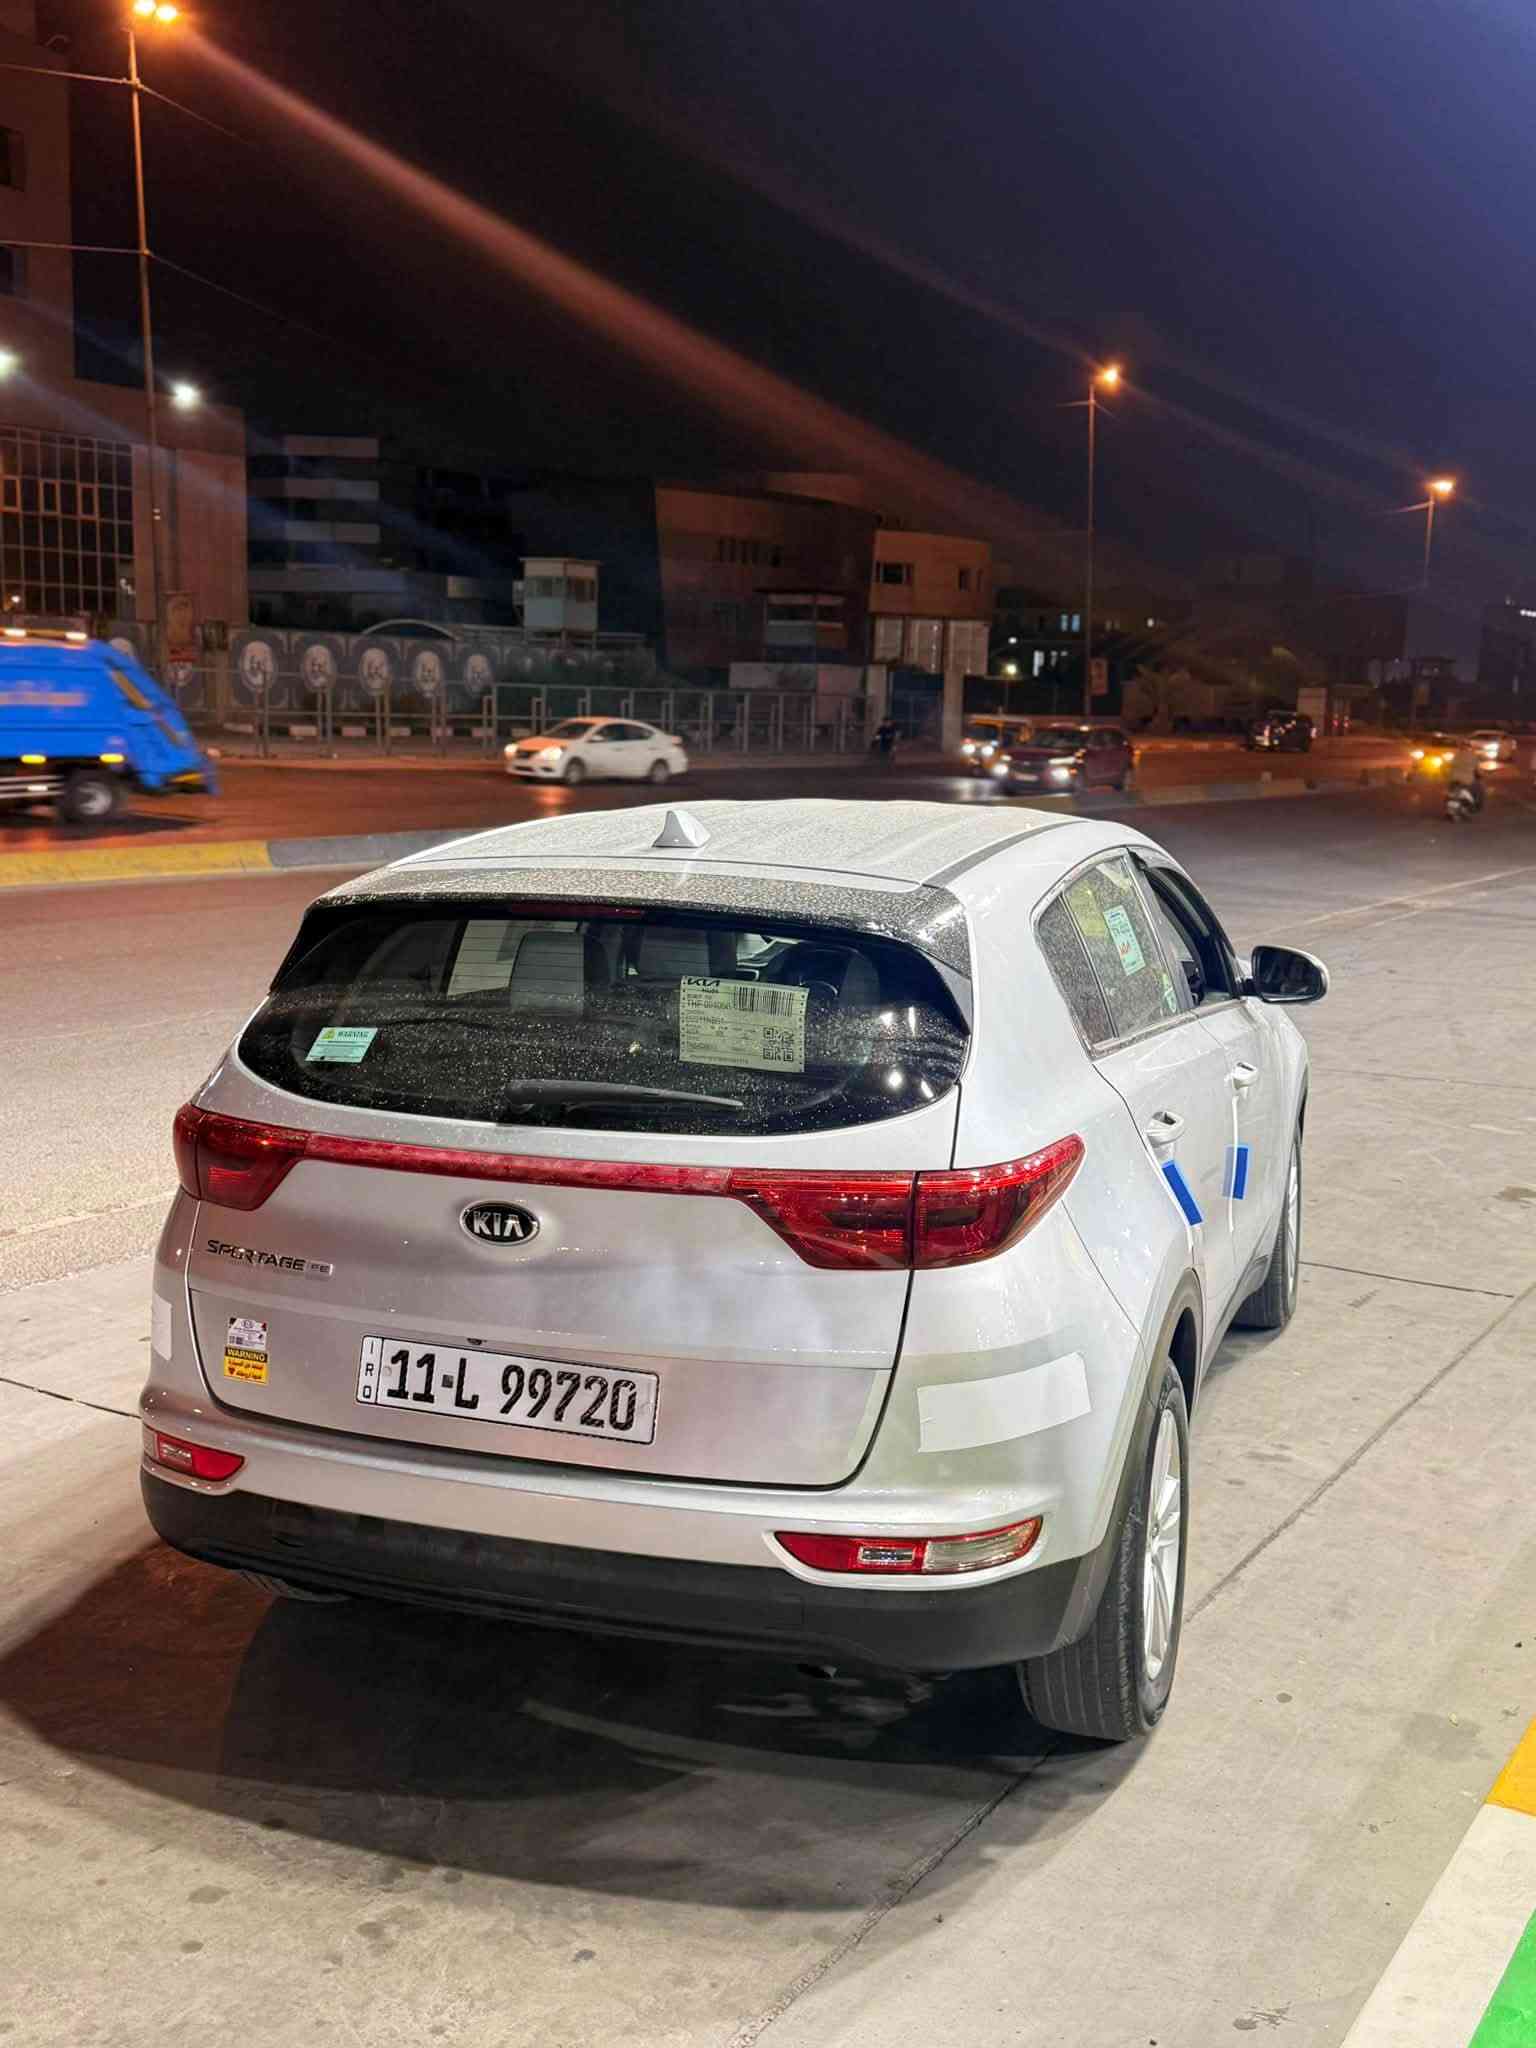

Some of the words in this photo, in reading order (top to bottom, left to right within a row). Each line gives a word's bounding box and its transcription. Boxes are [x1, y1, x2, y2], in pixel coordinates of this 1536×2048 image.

[472, 1210, 524, 1238] KIA
[206, 1239, 306, 1272] SPORTAGE
[499, 1364, 637, 1432] 99720
